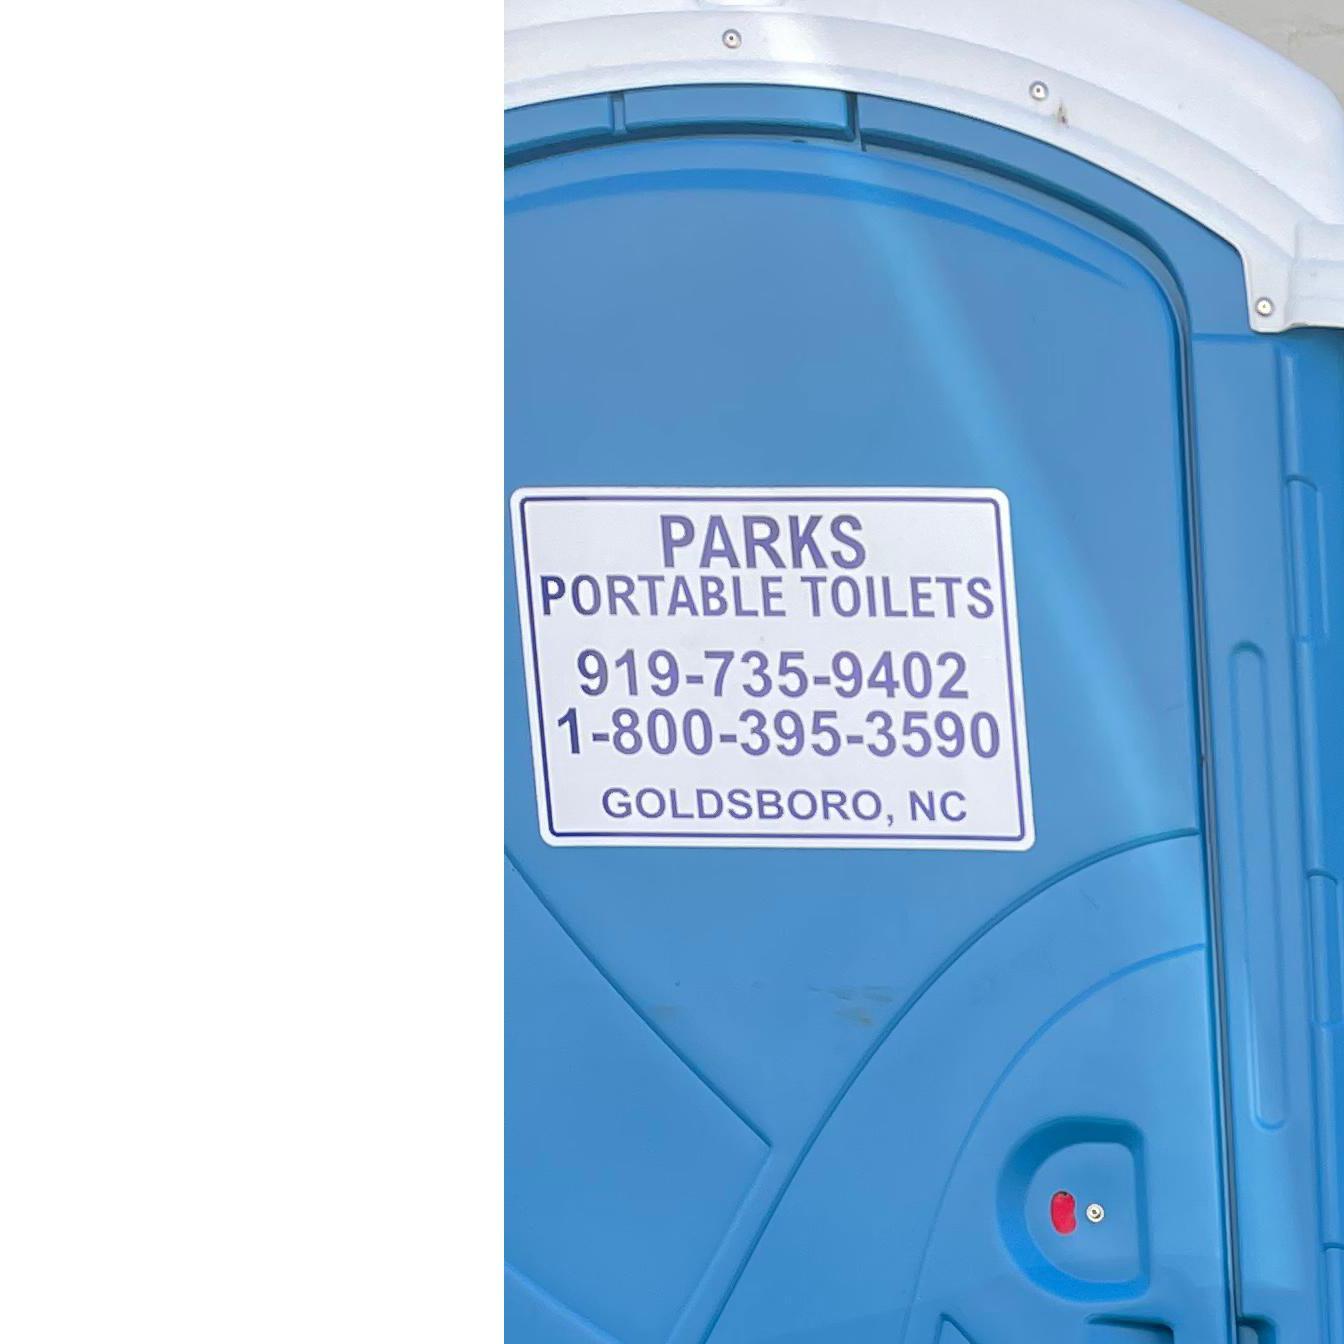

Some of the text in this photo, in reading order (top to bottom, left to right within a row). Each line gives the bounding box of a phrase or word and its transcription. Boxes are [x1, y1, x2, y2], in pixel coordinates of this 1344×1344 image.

[659, 514, 866, 570] PARKS
[539, 574, 994, 620] PORTABLE TOILETS
[576, 648, 969, 699] 919-735-9402
[557, 707, 1000, 759] 1-800-395-3590
[601, 787, 967, 827] GOLDSBORO, NC
